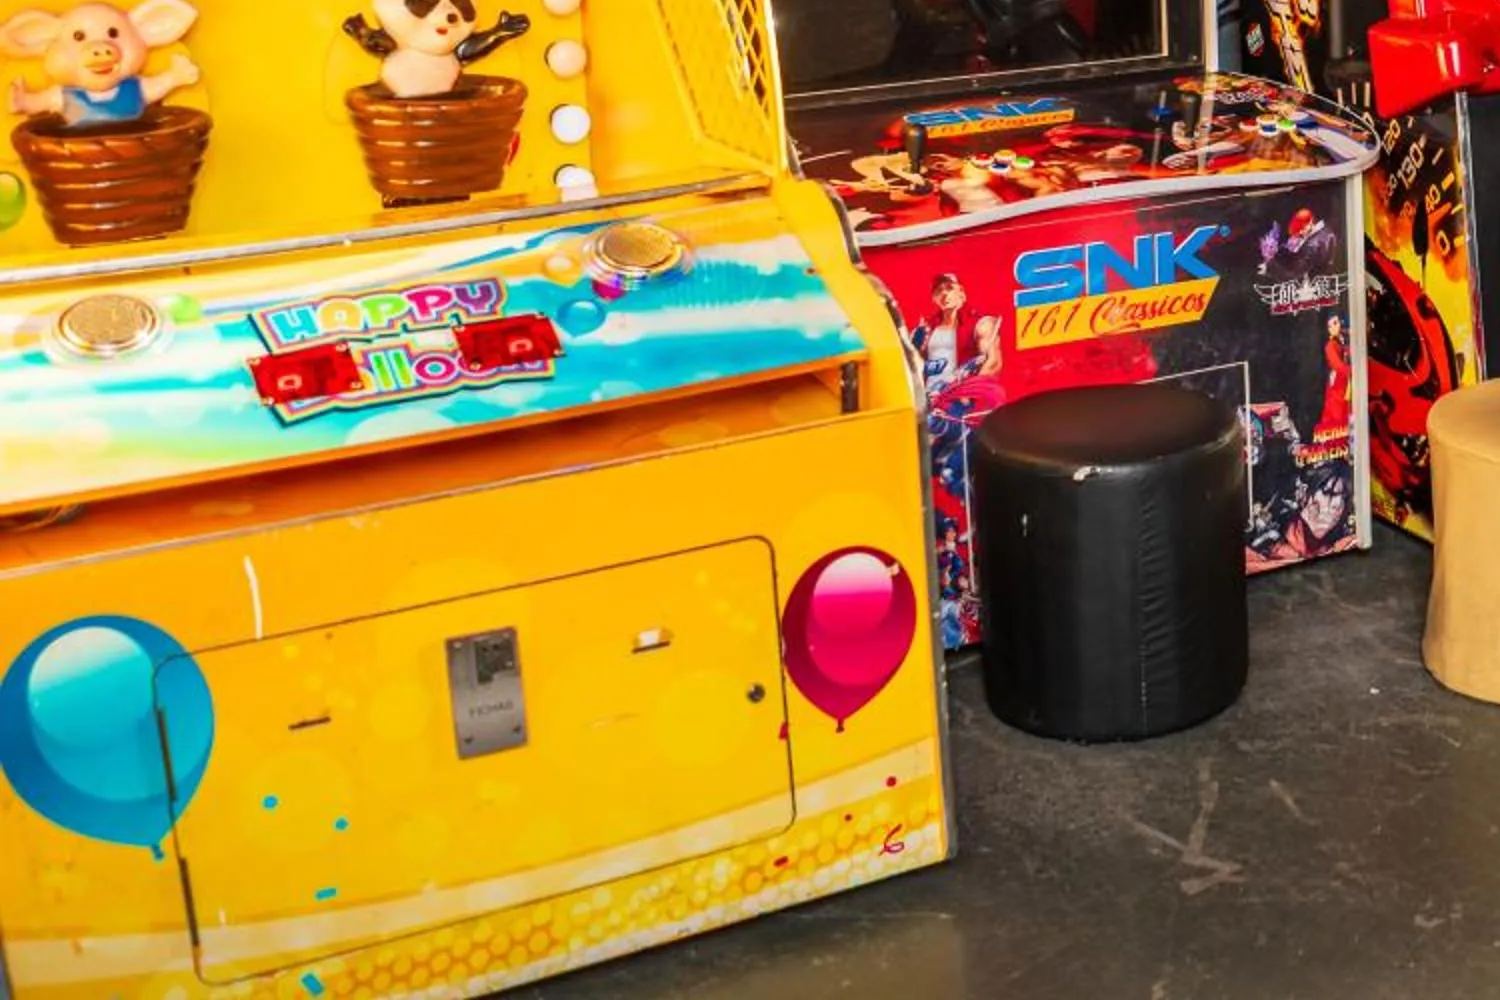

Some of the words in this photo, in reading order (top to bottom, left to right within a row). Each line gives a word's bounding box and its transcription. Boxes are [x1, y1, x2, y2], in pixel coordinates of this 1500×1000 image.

[1397, 141, 1424, 189] 130
[1014, 224, 1220, 308] SNK
[266, 280, 499, 345] HAPPY
[1021, 301, 1082, 338] 161
[1089, 293, 1207, 335] Classicos
